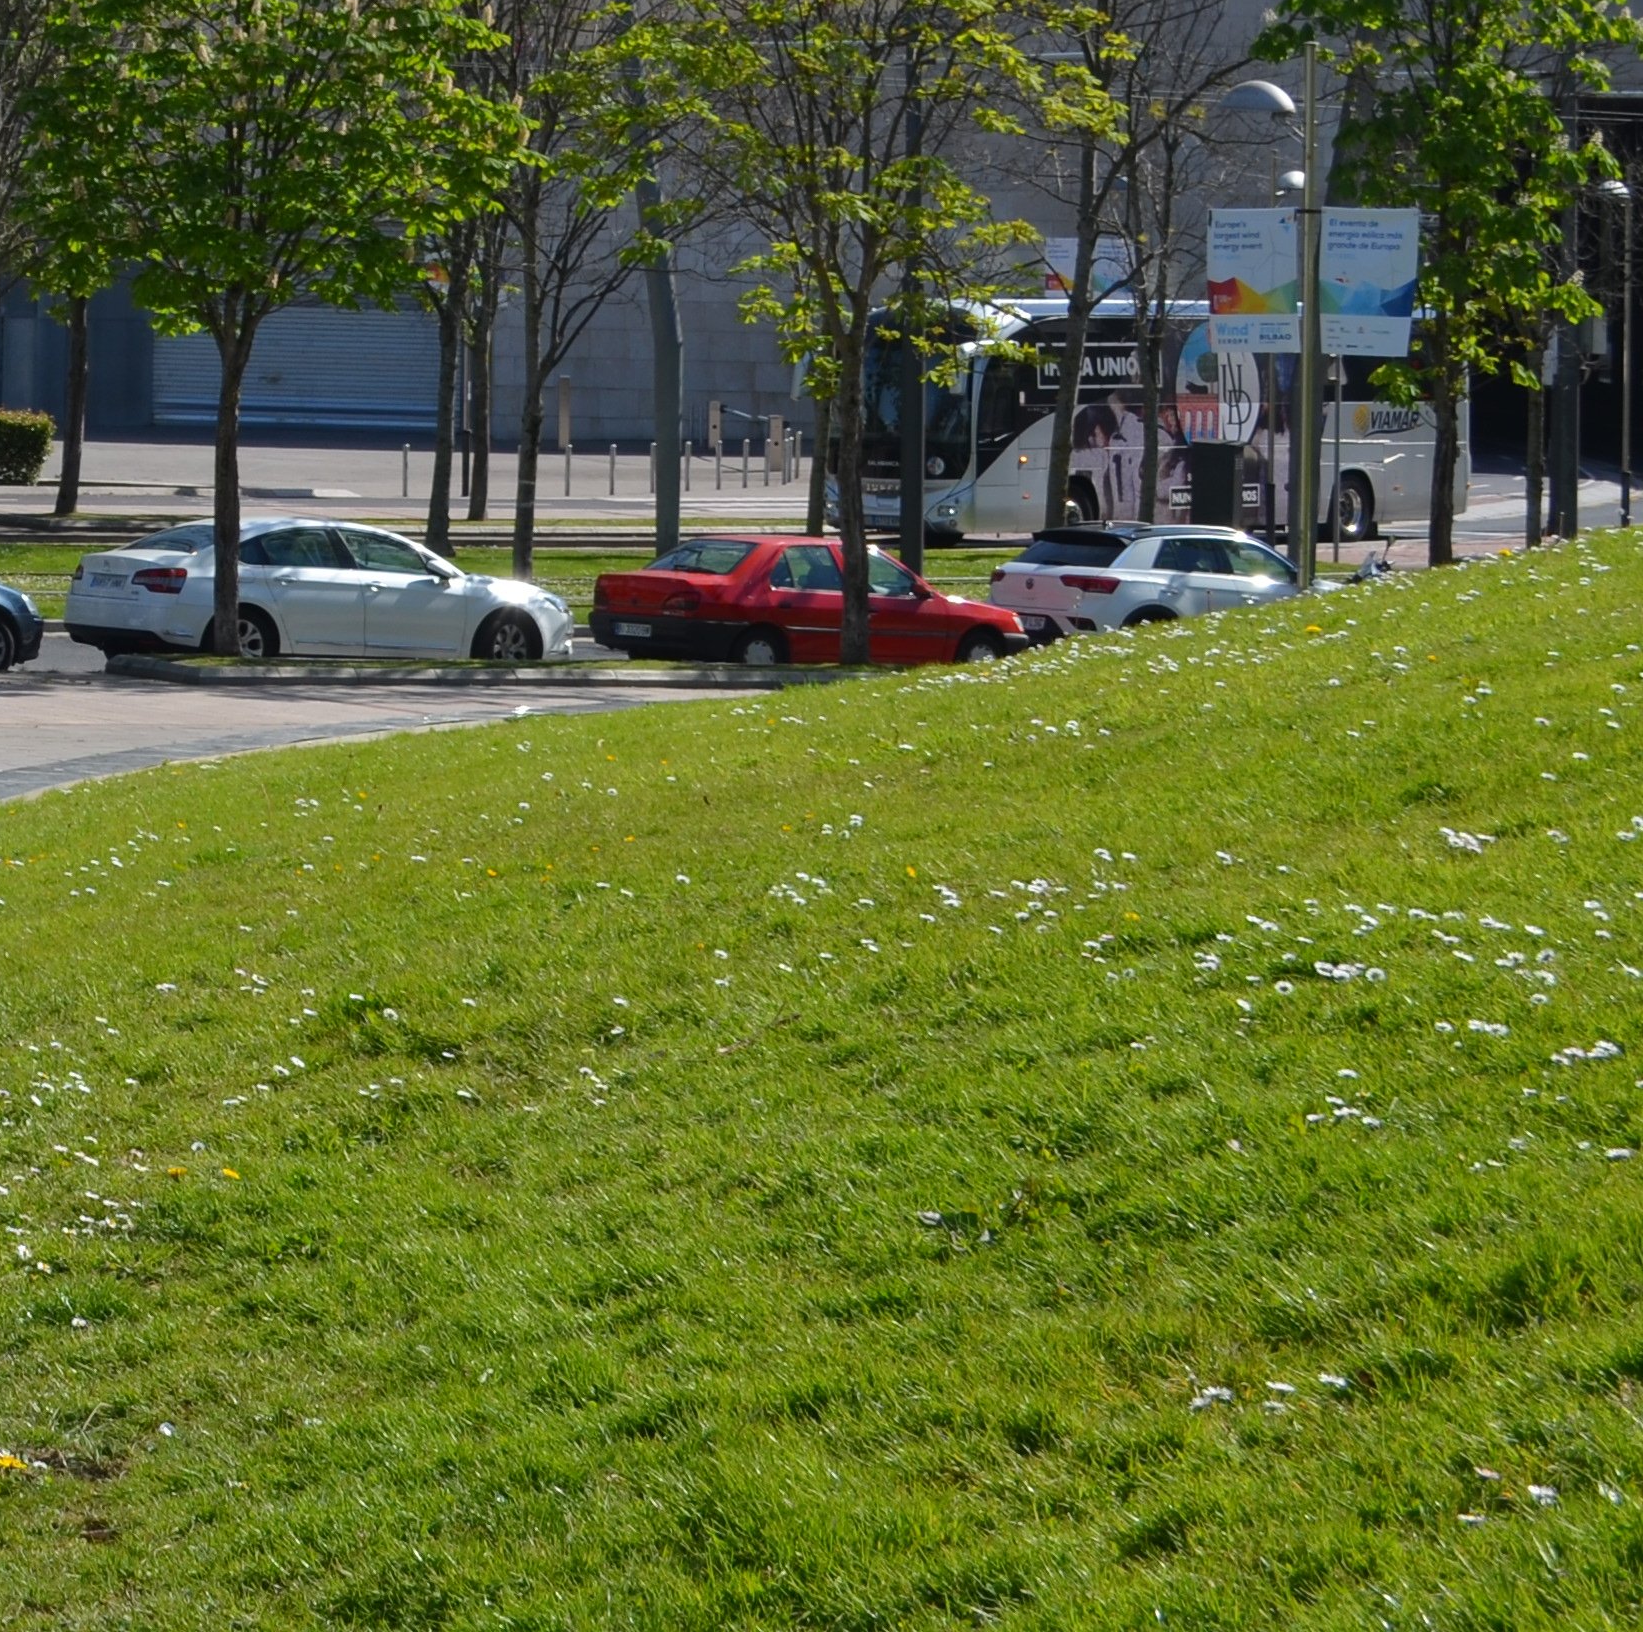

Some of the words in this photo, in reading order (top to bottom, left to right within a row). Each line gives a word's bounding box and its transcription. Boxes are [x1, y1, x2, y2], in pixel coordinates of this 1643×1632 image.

[1370, 241, 1400, 251] Europa
[1216, 322, 1248, 336] Wind
[1259, 333, 1292, 341] BILBAO
[1371, 410, 1419, 429] VIAMAR
